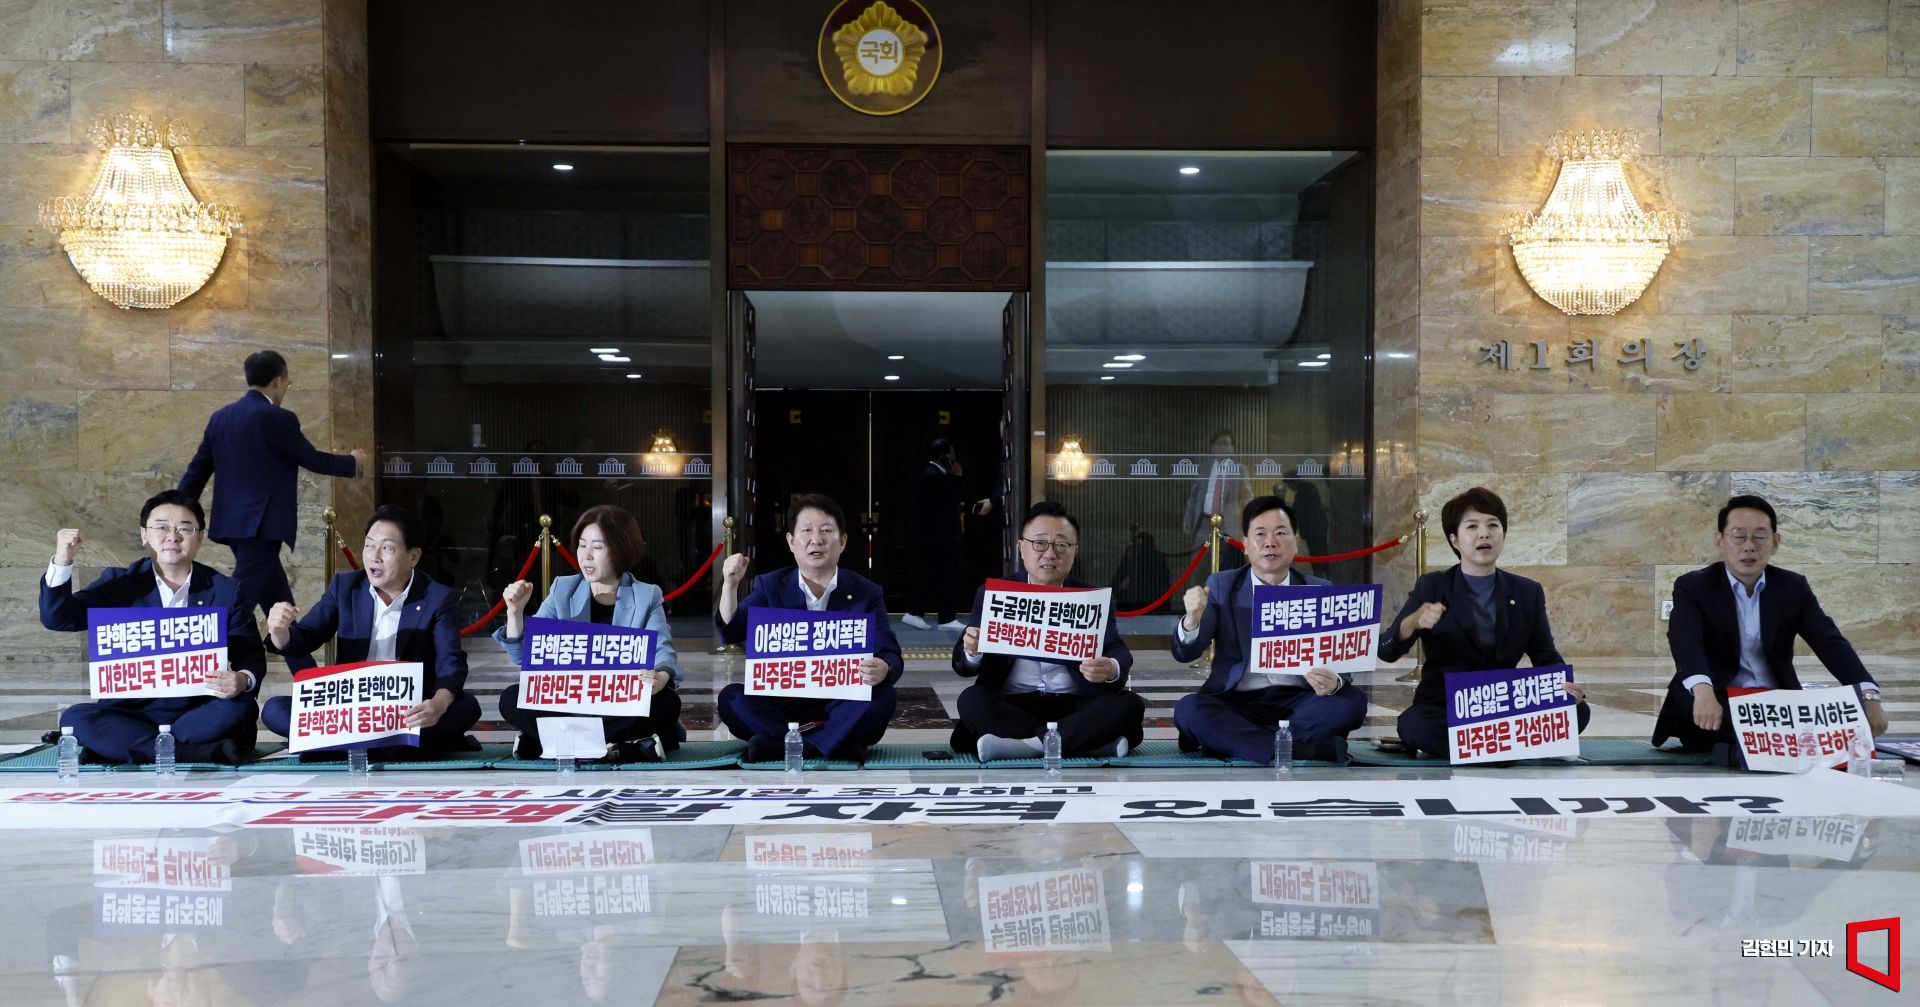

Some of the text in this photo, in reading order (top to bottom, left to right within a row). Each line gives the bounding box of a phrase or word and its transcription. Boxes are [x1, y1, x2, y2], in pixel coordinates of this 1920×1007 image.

[860, 40, 898, 64] 국회
[1477, 337, 1706, 370] 제1회의장
[990, 594, 1102, 630] 누굴위한 탄핵인가
[1261, 589, 1375, 632] 탄핵중독 민주당에
[96, 612, 219, 656] 탄핵중독 민주당에
[530, 633, 649, 666] 탄핵중독 민주당에
[754, 618, 868, 653] 이성잃은 정치폭력
[987, 620, 1098, 659] 탄핵정치 중단하라
[1258, 629, 1371, 669] 대한민국 무너진다
[98, 652, 219, 694] 대한민국 무너진다
[525, 673, 644, 705] 대한민국 무너진다
[752, 660, 806, 691] 민주당은
[299, 675, 415, 709] 누굴위한 탄핵인가
[1454, 670, 1568, 719] 이성잃은 정치폭력
[298, 707, 353, 737] 탄핵정치
[1737, 700, 1859, 729] 의회주의 무시하는
[1456, 710, 1570, 760] 민주당은 각성하라
[1742, 730, 1800, 758] 편파운영
[832, 785, 1096, 797] 조사하고
[244, 797, 1784, 824] 탄핵할 자격 있습니까?
